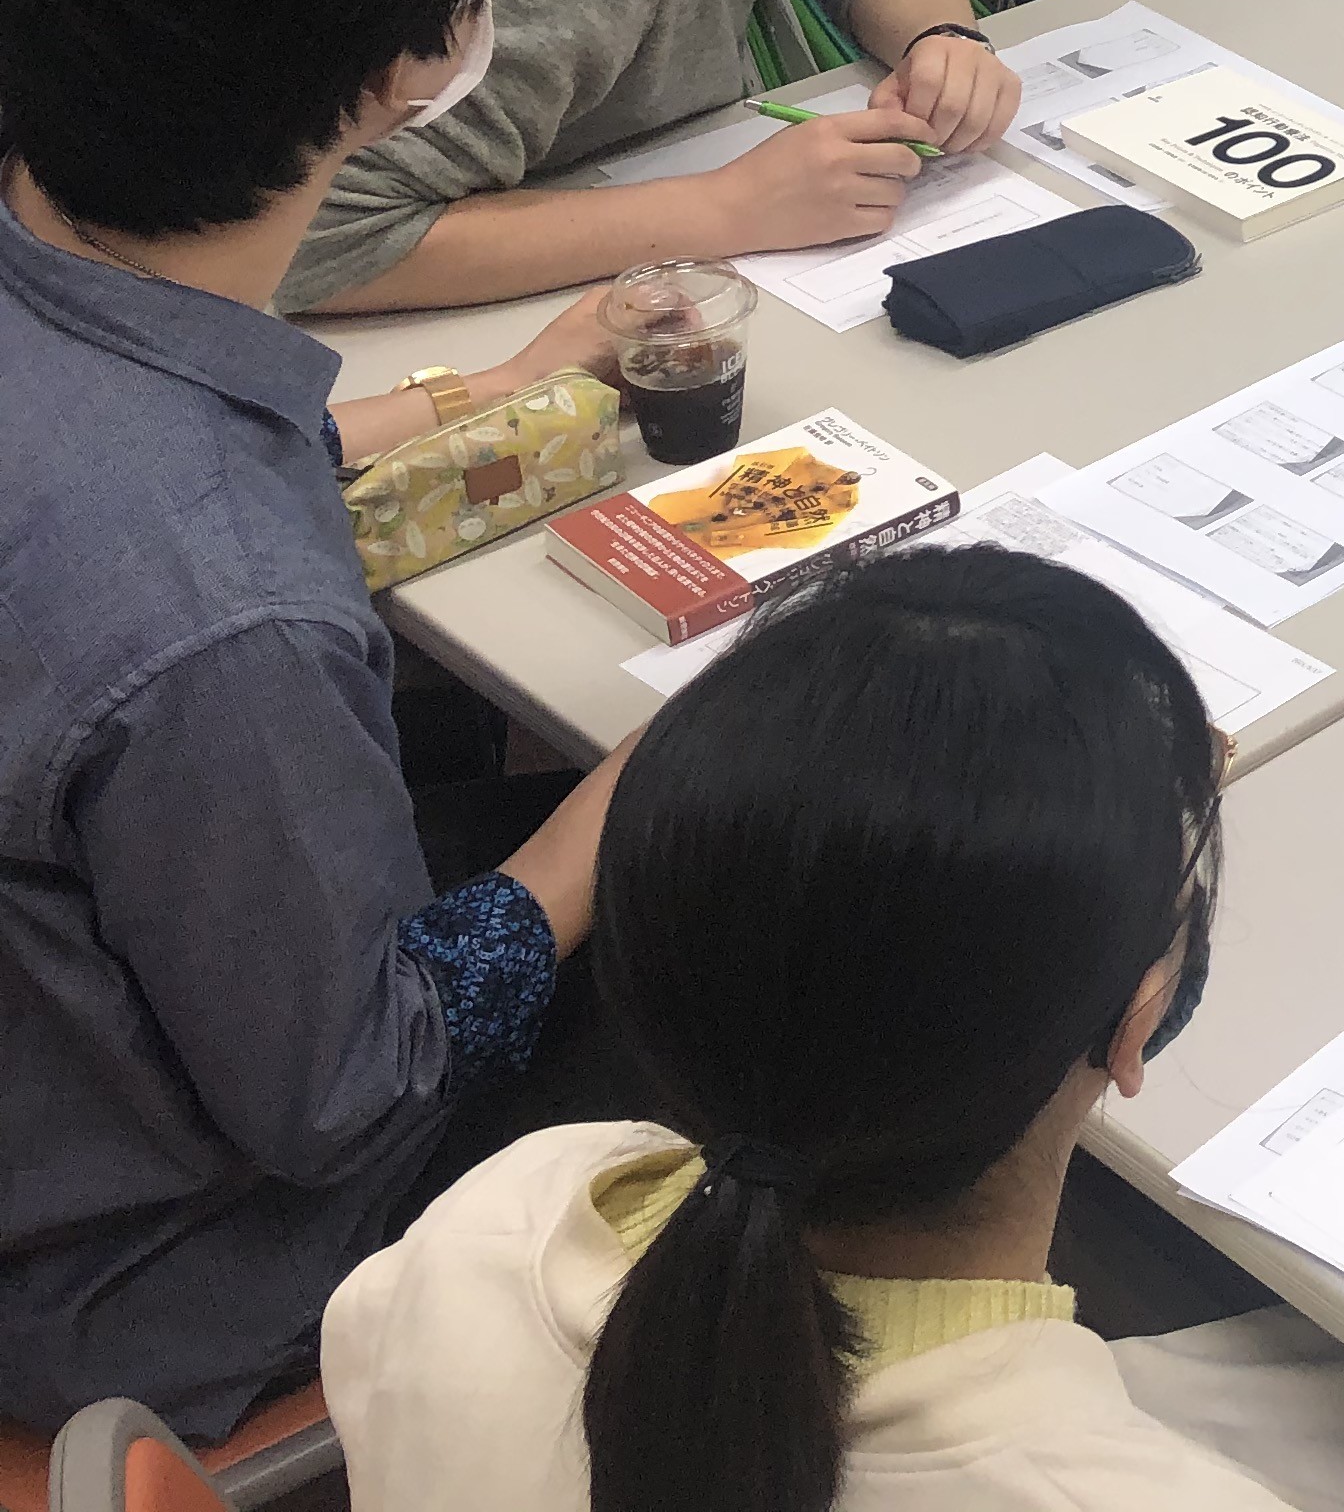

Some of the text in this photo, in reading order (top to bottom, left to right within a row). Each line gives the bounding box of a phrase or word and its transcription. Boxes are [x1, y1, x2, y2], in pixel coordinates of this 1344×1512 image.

[1239, 105, 1310, 141] 認知行動療法
[1185, 116, 1337, 189] 100
[1225, 170, 1276, 200] のポイント
[737, 462, 832, 525] 精神と自然
[858, 500, 951, 556] 精神と自然
